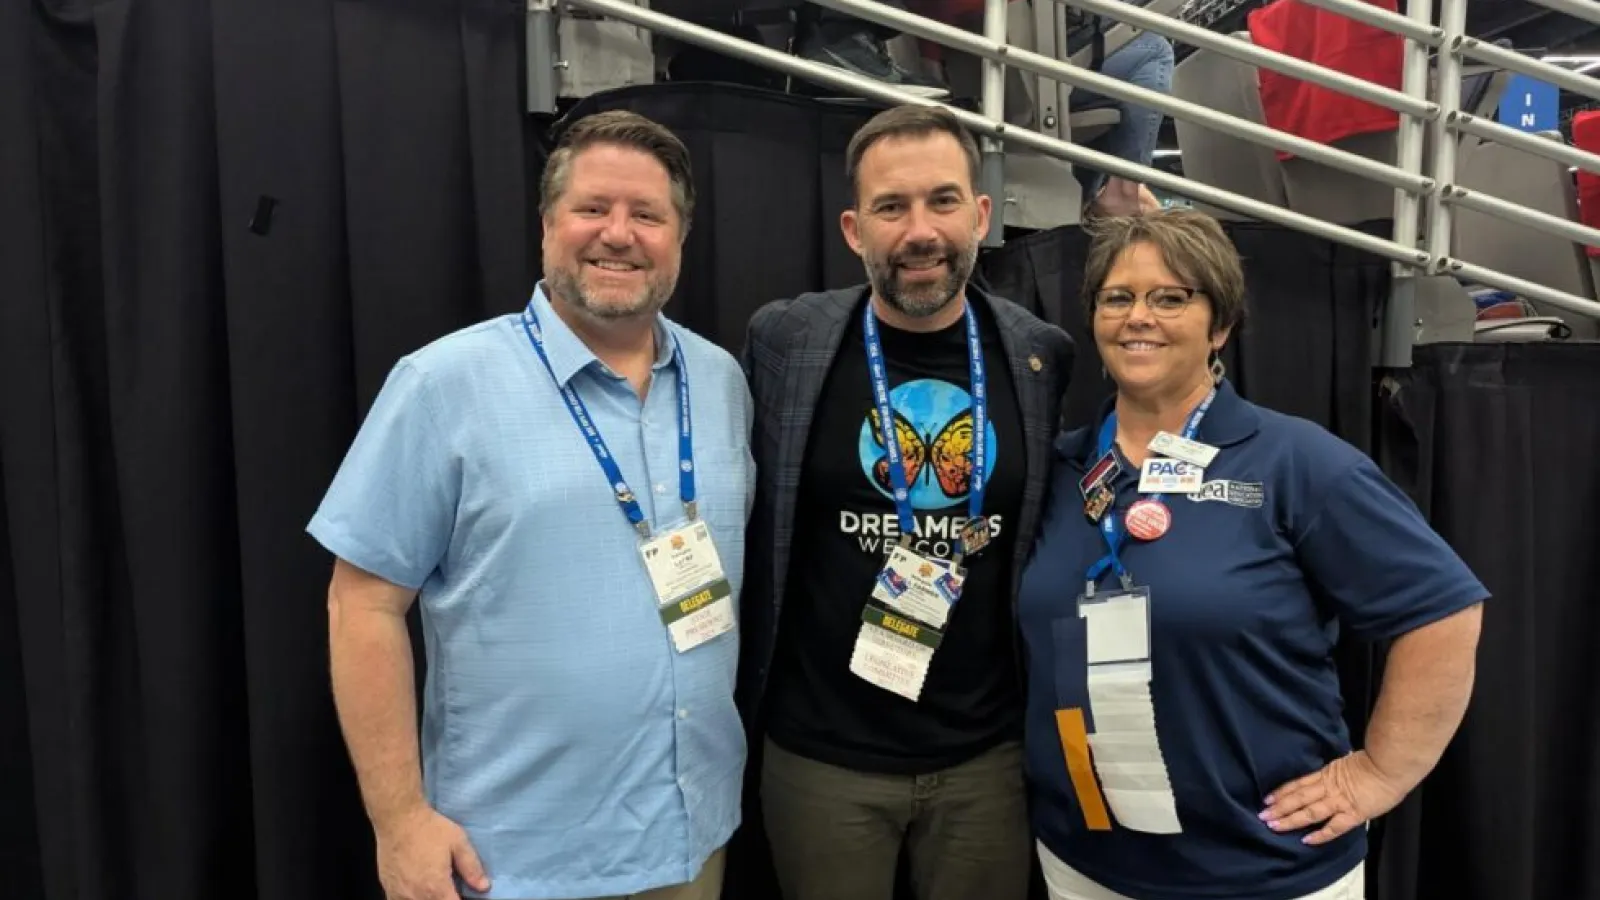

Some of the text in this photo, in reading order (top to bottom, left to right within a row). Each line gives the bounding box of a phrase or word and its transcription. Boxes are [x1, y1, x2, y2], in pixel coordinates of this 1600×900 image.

[840, 511, 1003, 539] DREAMES
[680, 589, 712, 613] DELEGATE
[881, 613, 919, 637] DELEGATE
